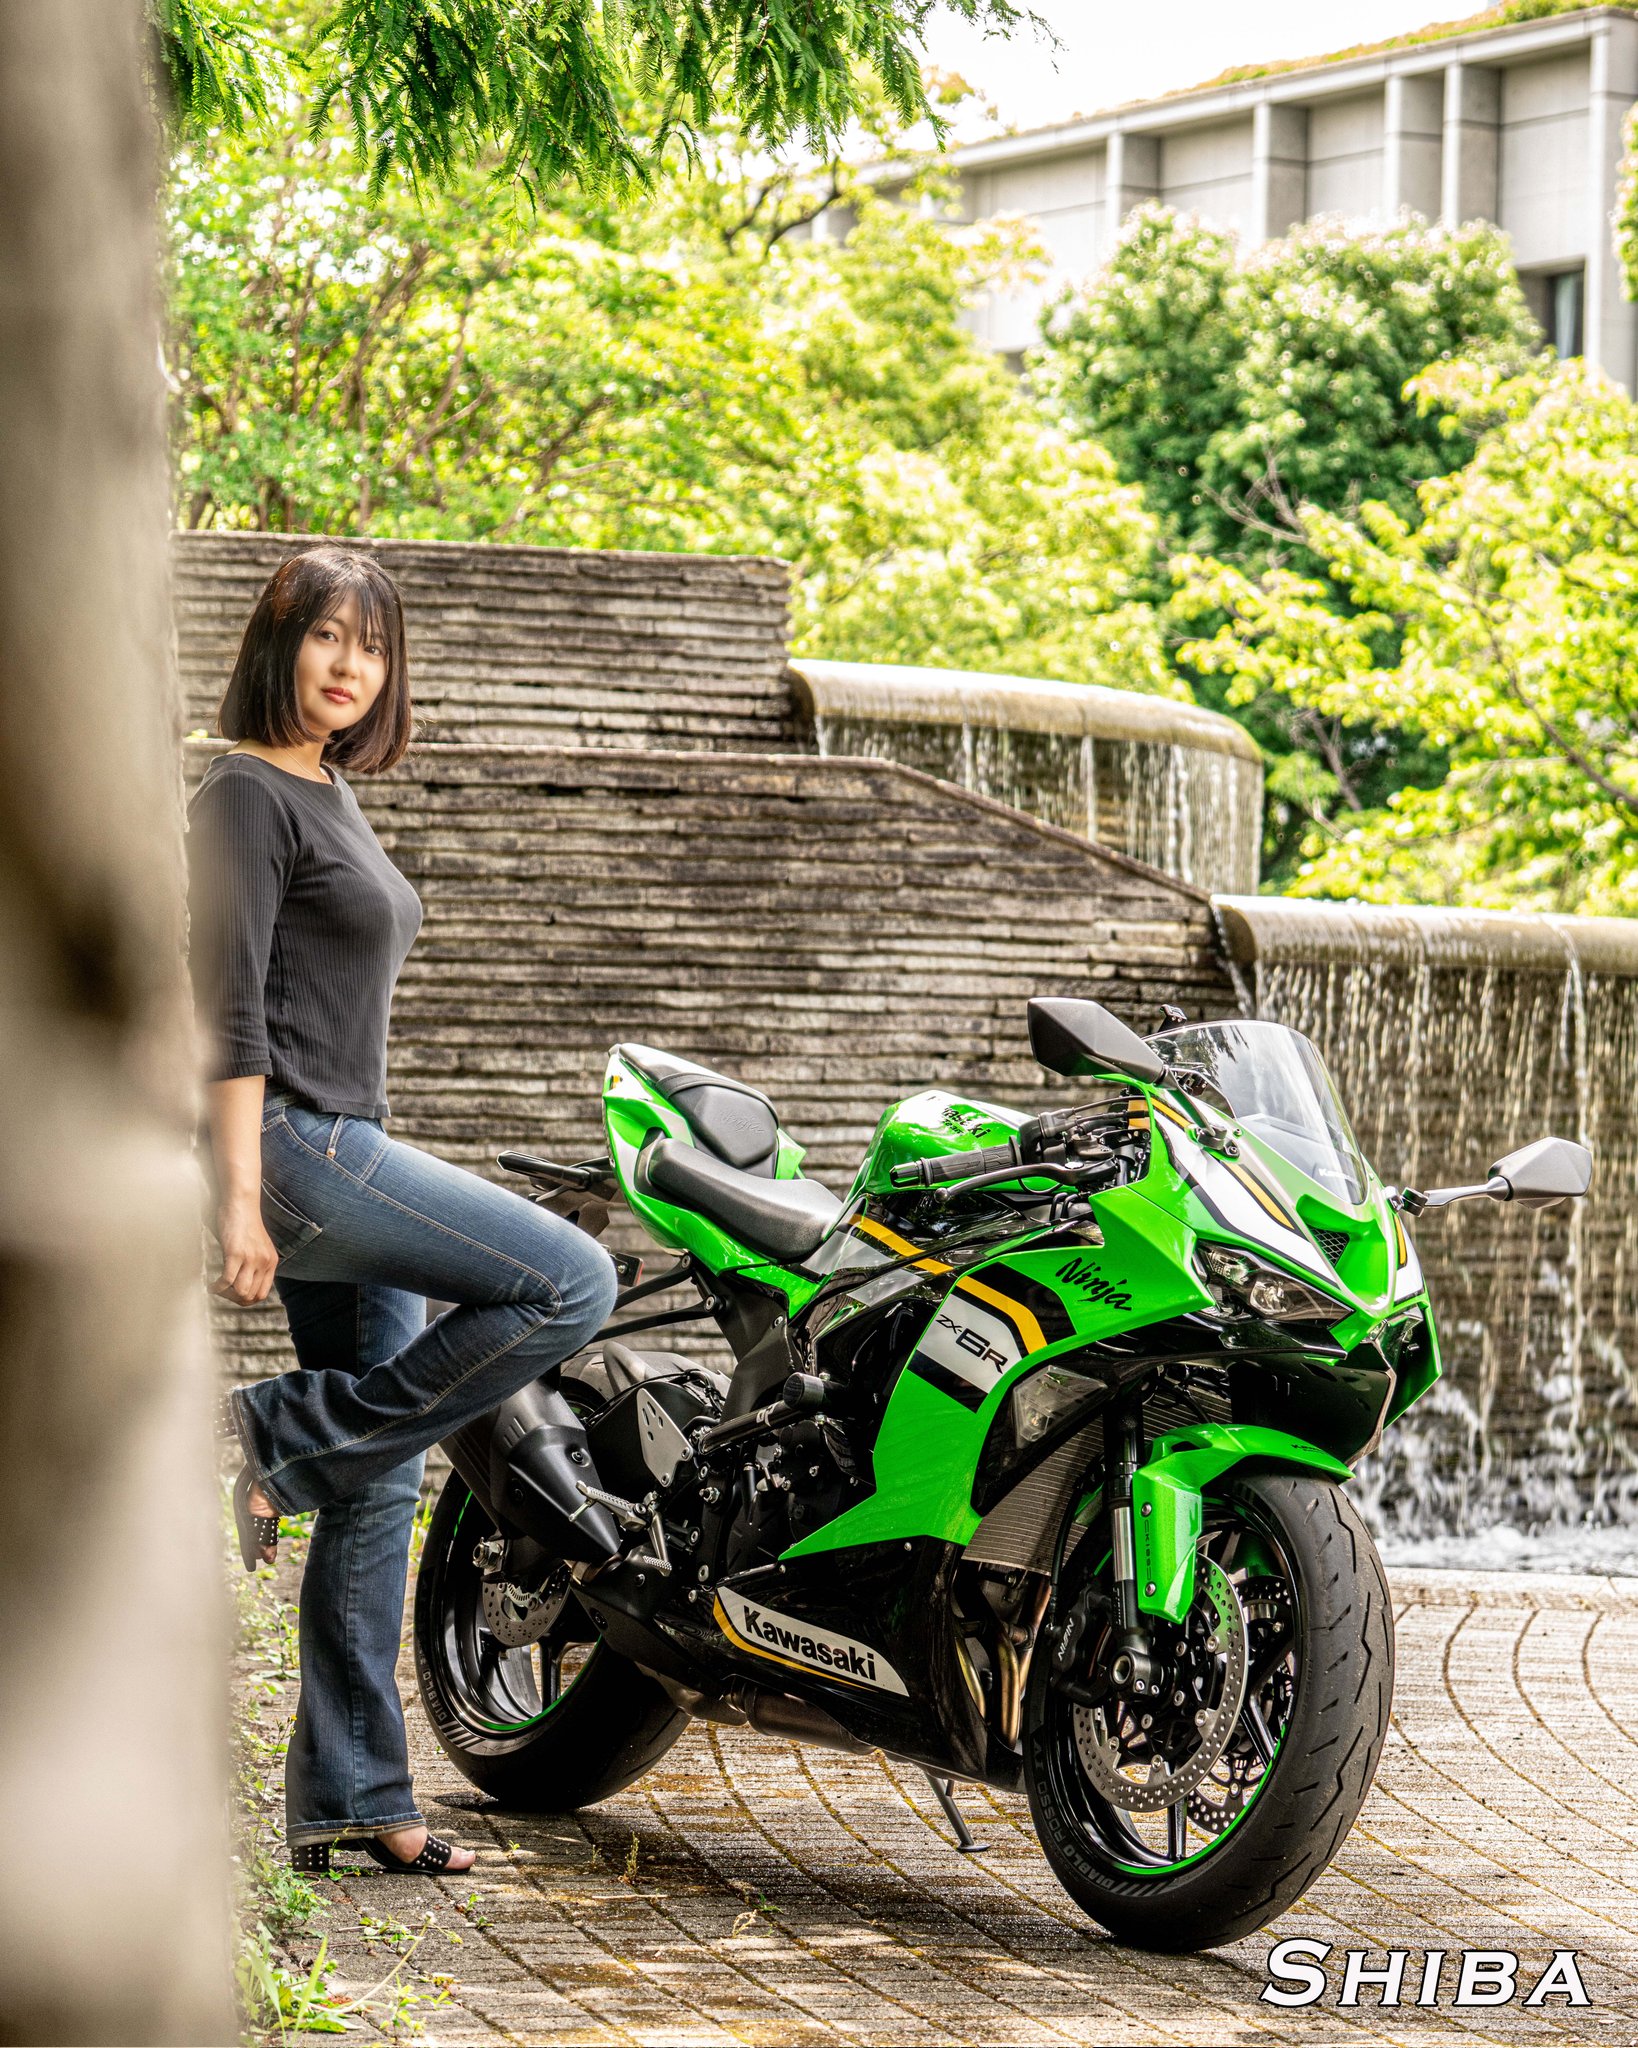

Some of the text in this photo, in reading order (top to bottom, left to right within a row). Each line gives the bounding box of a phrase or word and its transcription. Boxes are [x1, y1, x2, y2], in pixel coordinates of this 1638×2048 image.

[1055, 1256, 1133, 1311] Ninja
[934, 1313, 1009, 1375] ZX-6R
[743, 1604, 877, 1682] Kawasaki
[422, 1666, 448, 1722] DIABLO
[1037, 1781, 1066, 1843] ROSSO
[1063, 1843, 1115, 1890] DIABLO
